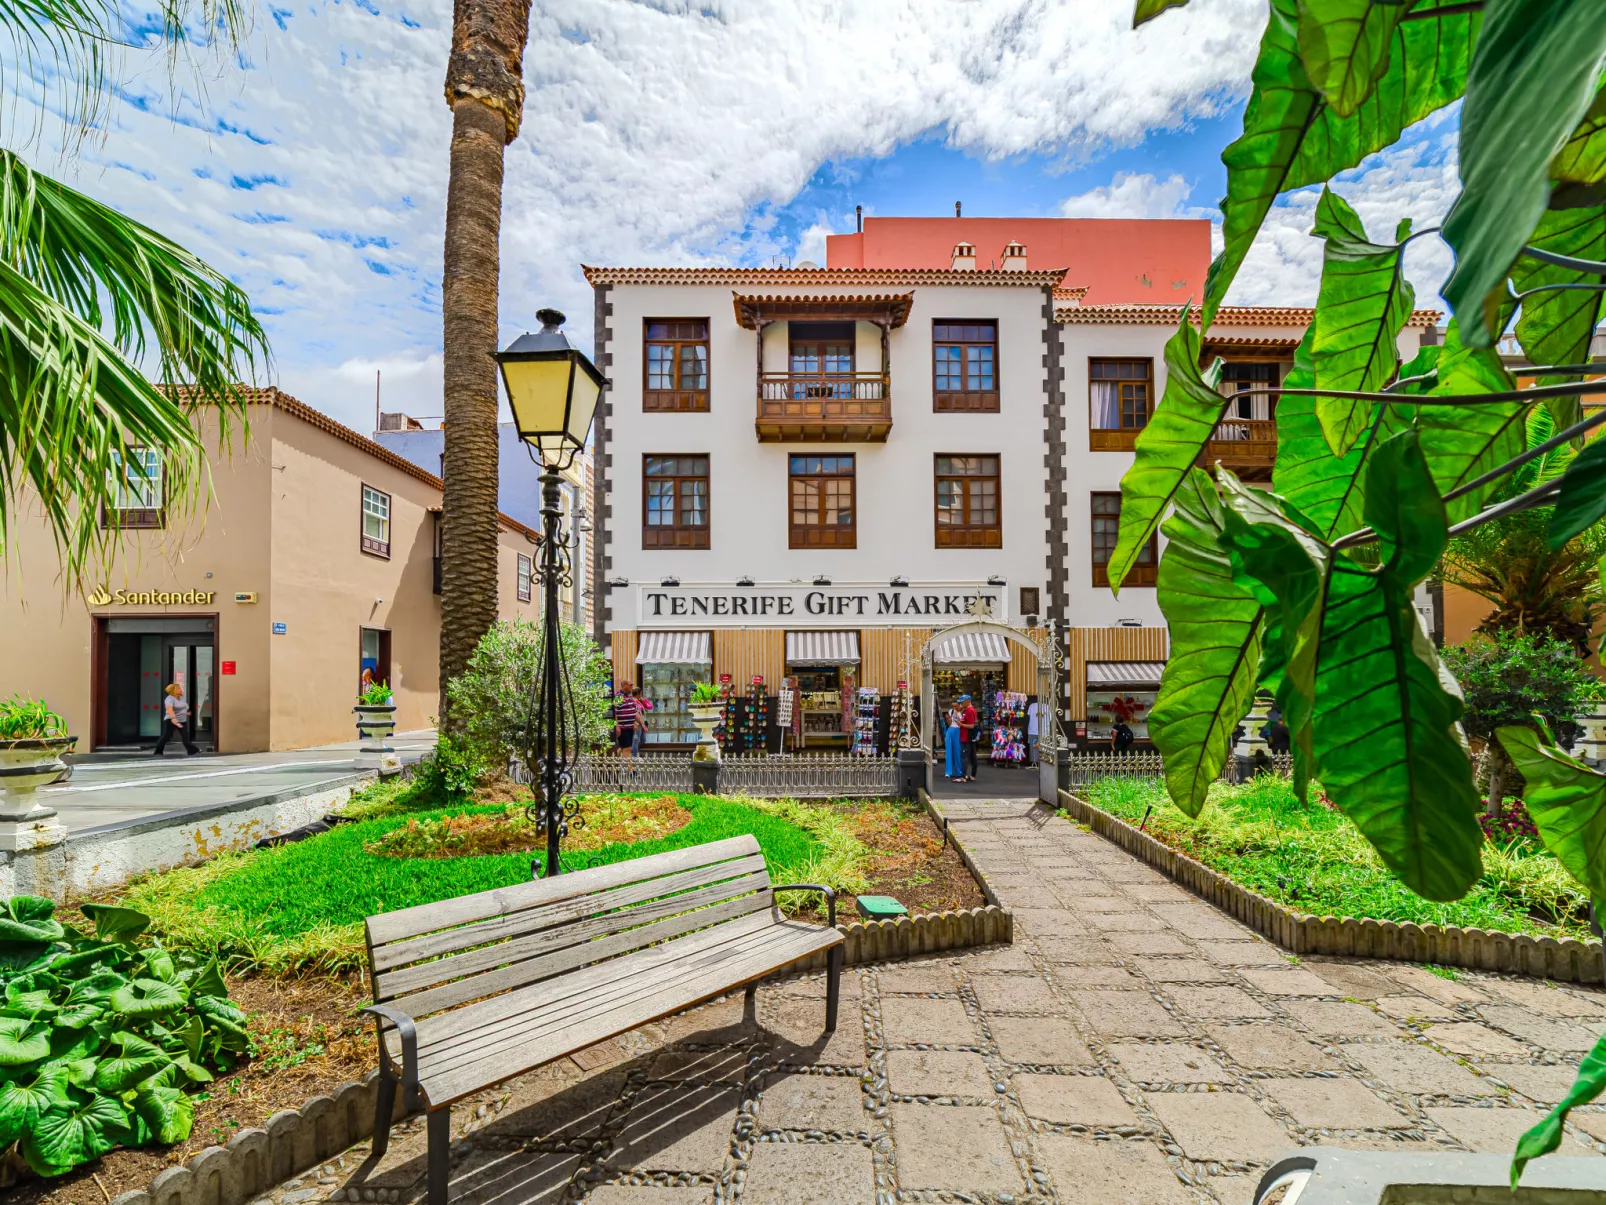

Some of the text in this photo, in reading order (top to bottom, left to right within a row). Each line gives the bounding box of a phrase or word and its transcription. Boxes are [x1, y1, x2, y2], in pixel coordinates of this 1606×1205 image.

[115, 588, 216, 605] Santander
[647, 593, 795, 616] TENERIFE
[804, 591, 870, 615] GIFT
